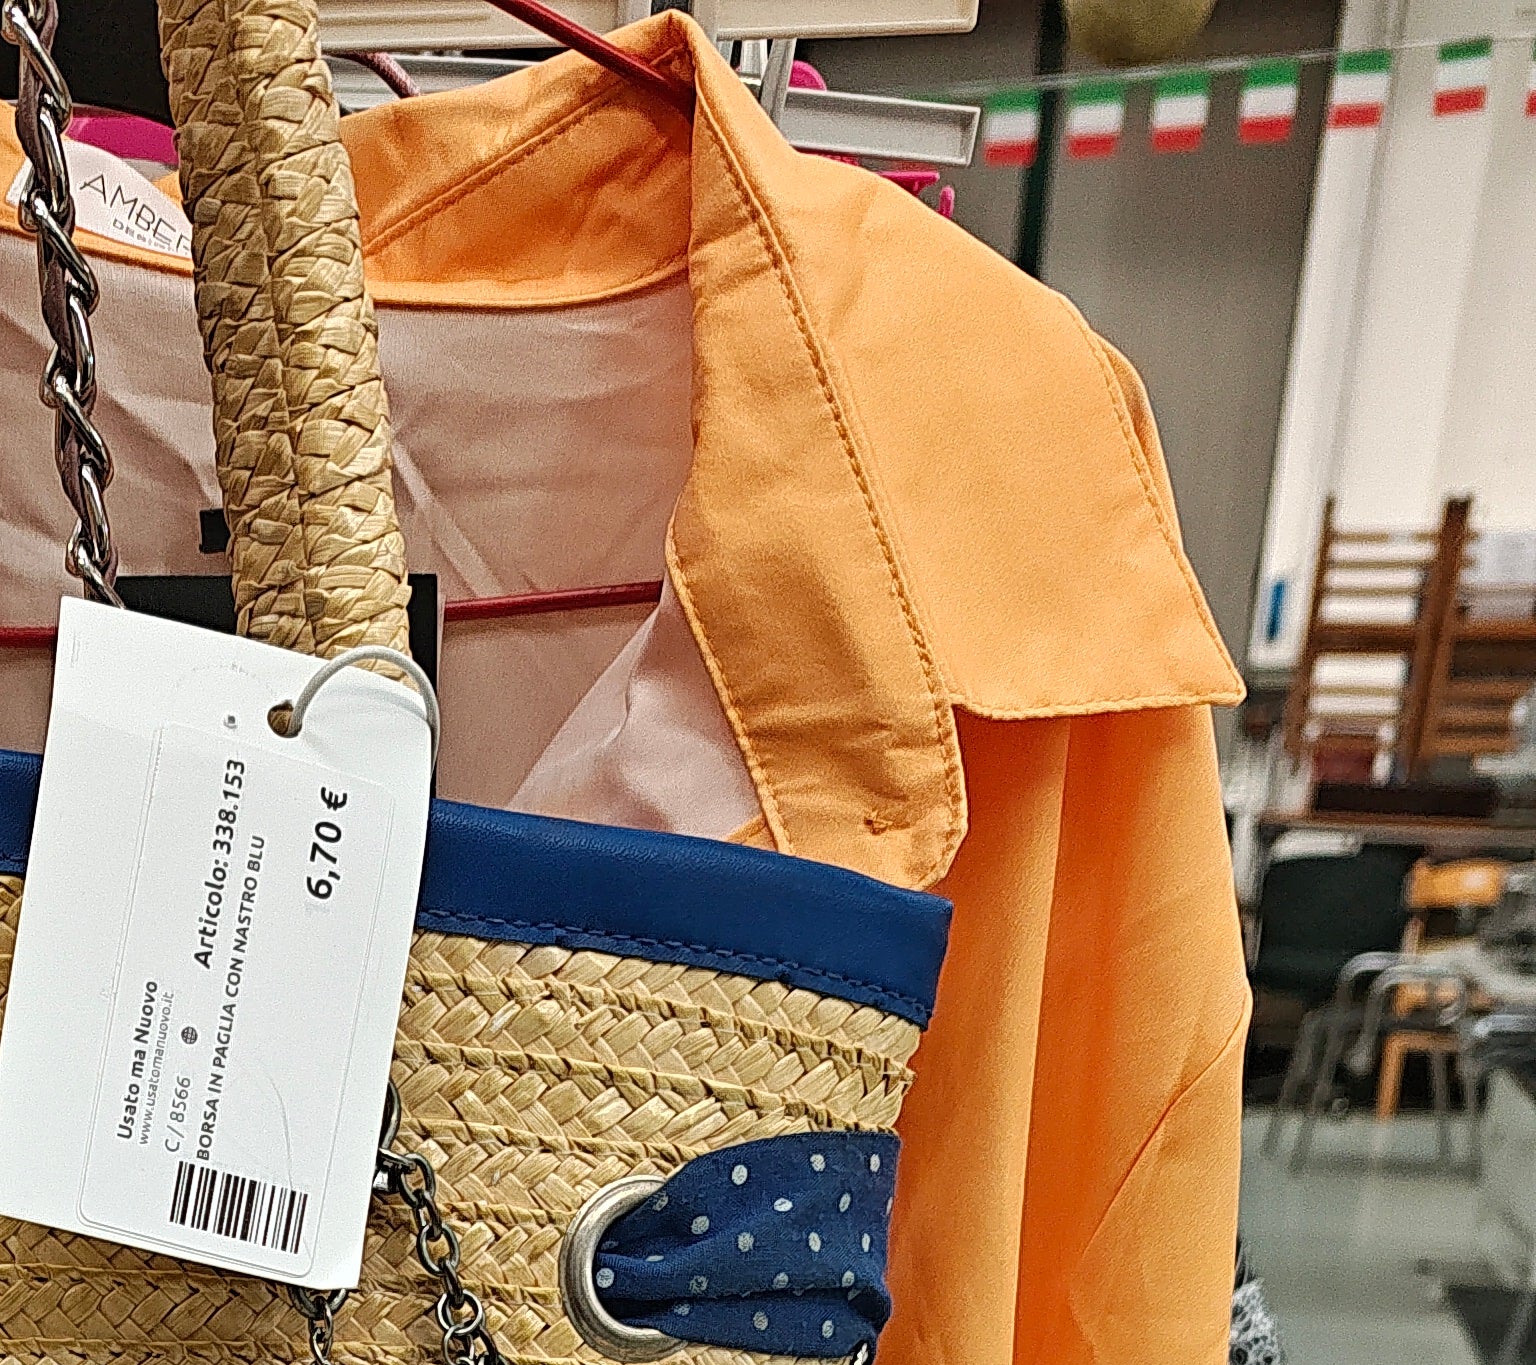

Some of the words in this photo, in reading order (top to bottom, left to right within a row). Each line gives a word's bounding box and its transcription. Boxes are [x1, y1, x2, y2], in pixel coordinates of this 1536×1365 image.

[320, 786, 348, 811] €
[194, 859, 228, 969] Articolo:
[213, 759, 245, 854] 338.153
[247, 835, 265, 872] BLU
[307, 821, 342, 900] 6,70
[233, 877, 258, 953] NASTRO
[225, 957, 244, 997] CON
[134, 981, 158, 1044] Nuovo
[213, 1003, 236, 1068] PAGLIA
[131, 1049, 146, 1078] ma
[139, 991, 174, 1145] www.usatomanuovo.it
[207, 1073, 223, 1094] IN
[117, 1083, 140, 1140] Usato
[196, 1099, 219, 1161] BORSA
